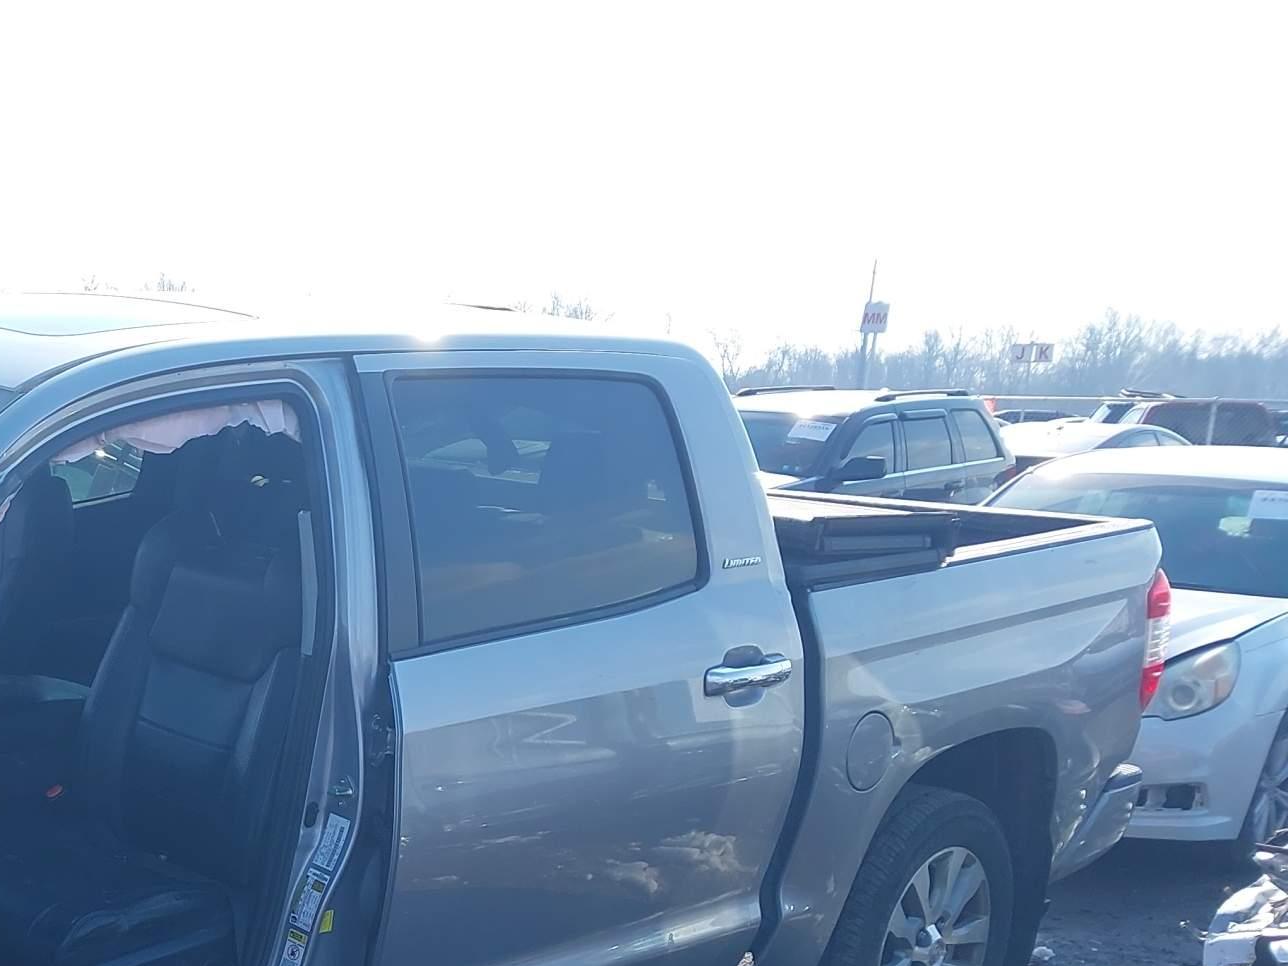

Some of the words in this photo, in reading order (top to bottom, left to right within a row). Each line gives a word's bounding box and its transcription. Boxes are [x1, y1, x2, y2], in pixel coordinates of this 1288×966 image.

[862, 311, 888, 325] MM
[1015, 346, 1025, 360] J
[1037, 345, 1050, 360] K
